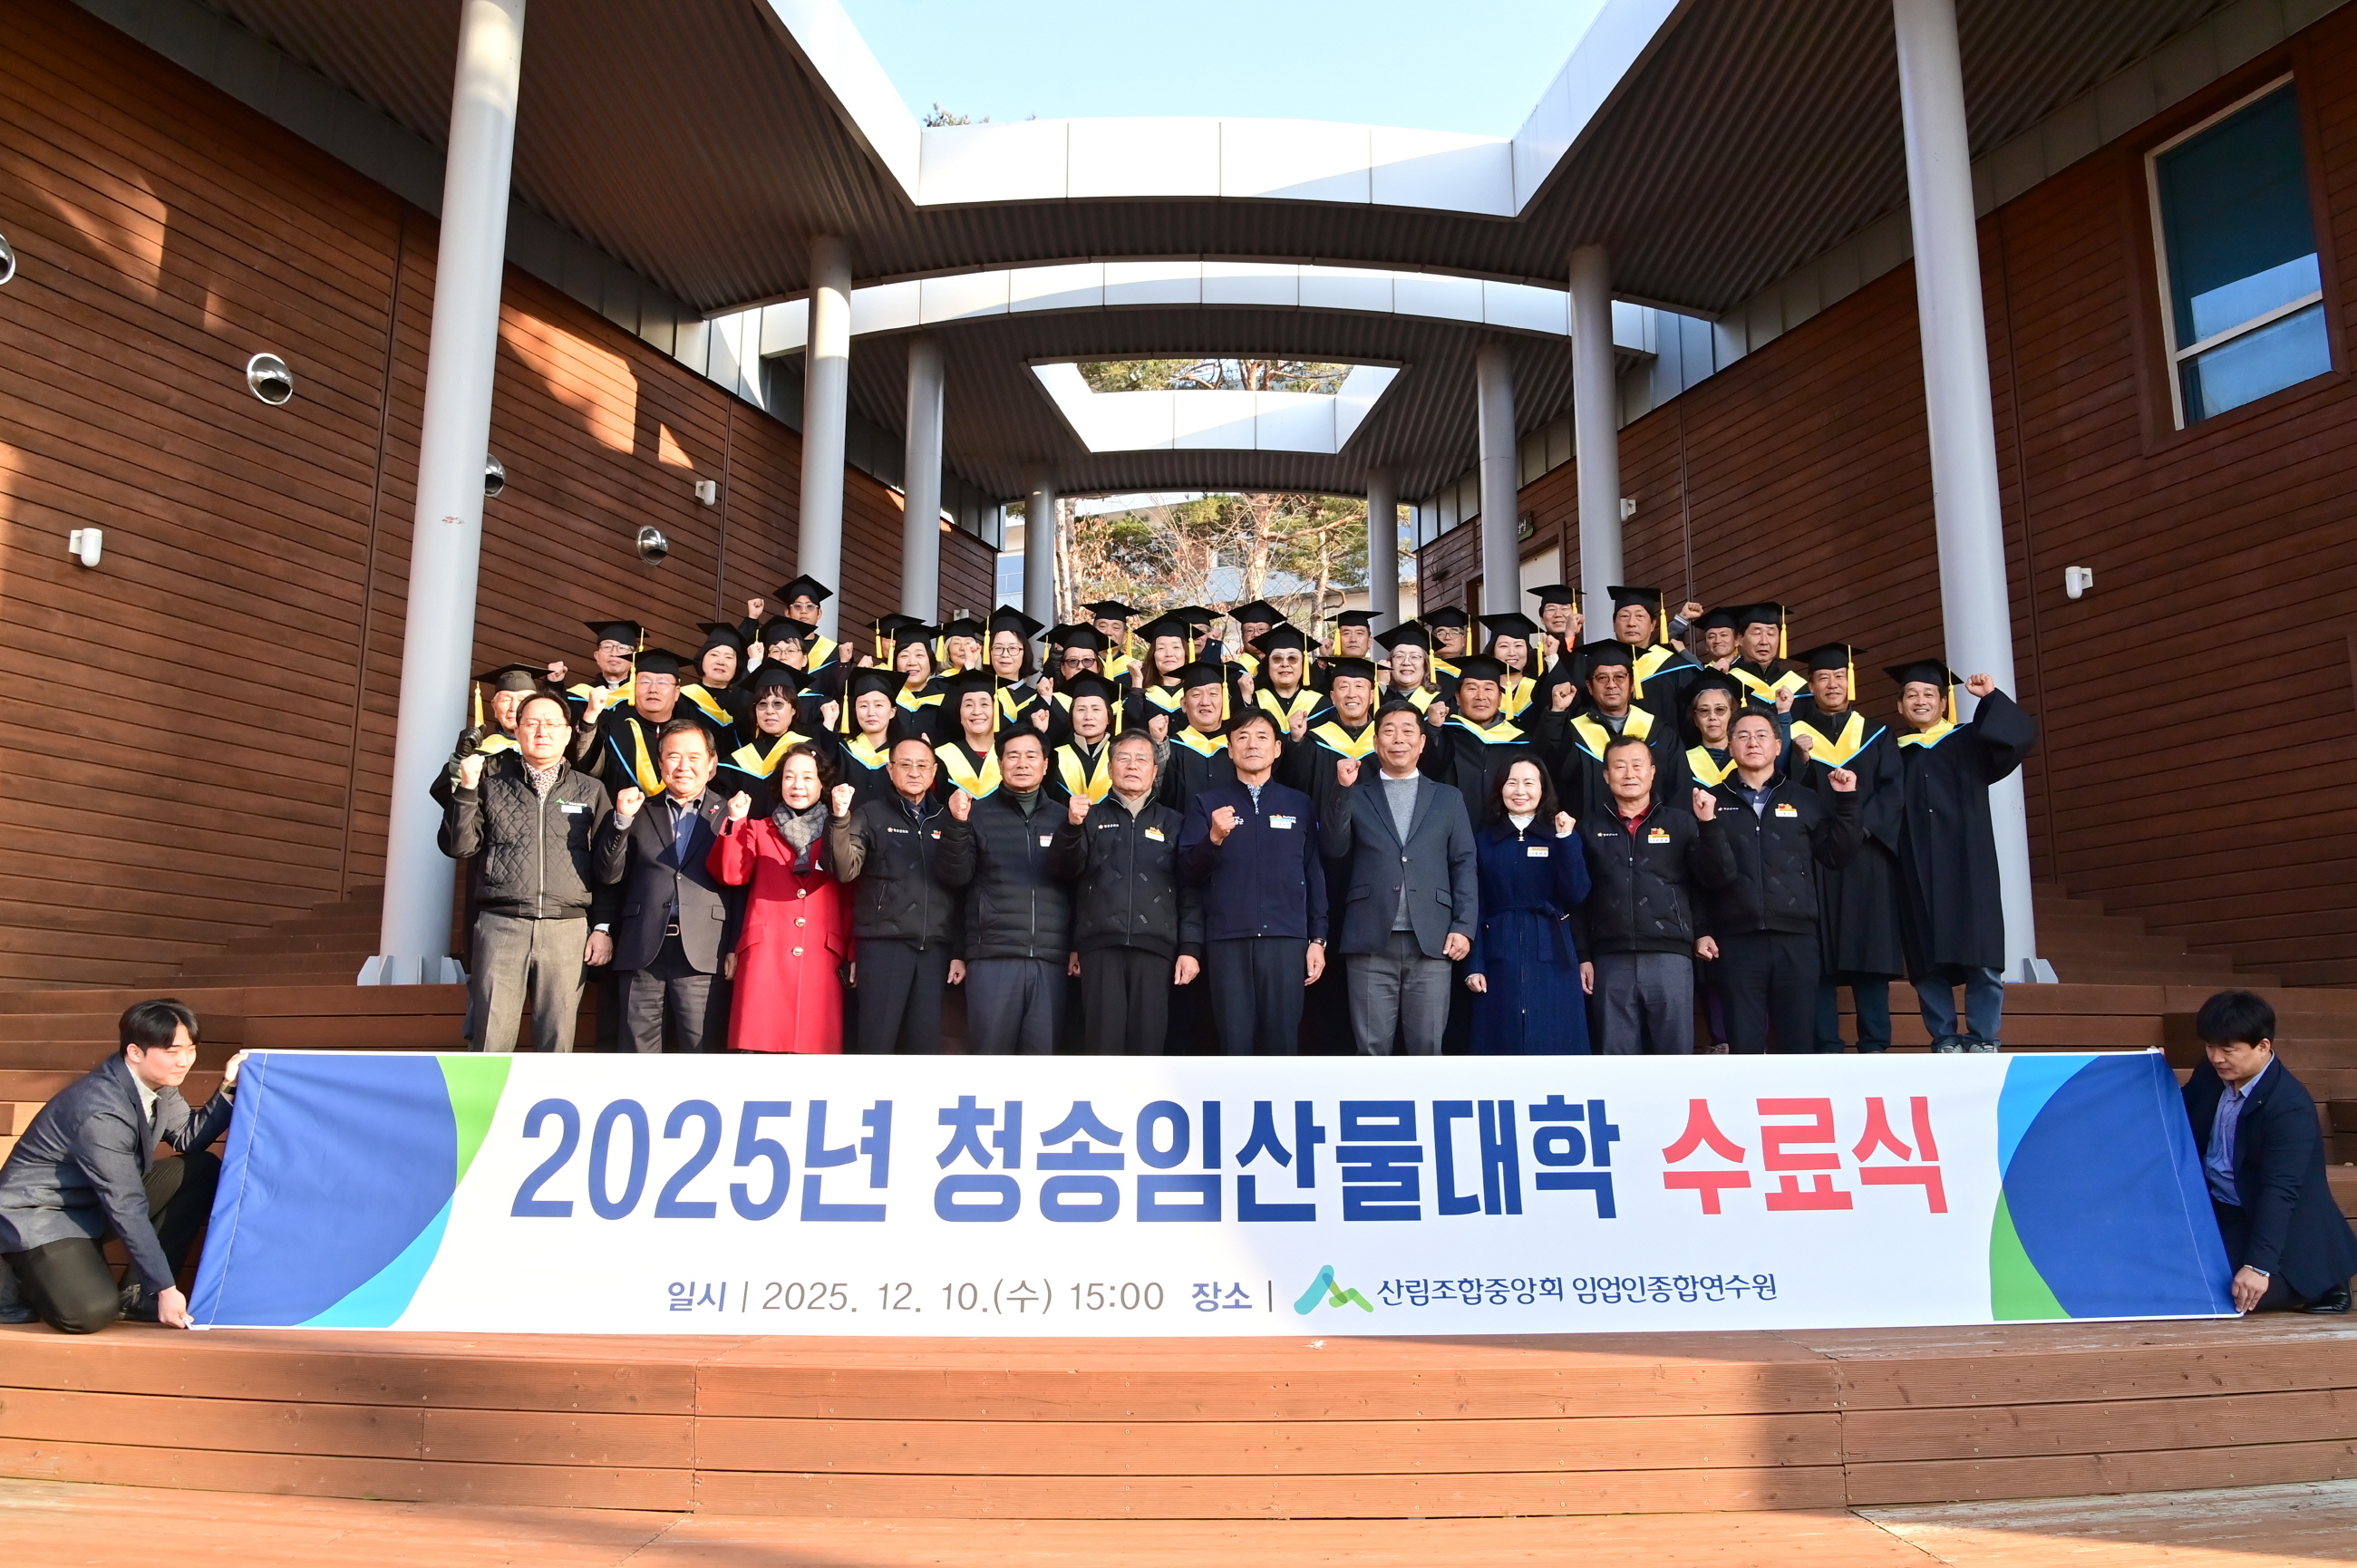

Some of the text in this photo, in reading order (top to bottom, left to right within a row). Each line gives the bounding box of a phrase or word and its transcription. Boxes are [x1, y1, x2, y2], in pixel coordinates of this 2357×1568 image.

[509, 1094, 1949, 1224] 2025년 청송임산물대학 수료식
[667, 1281, 726, 1312] 일시
[761, 1282, 858, 1312] 2025.
[878, 1282, 921, 1312] 12.
[1071, 1282, 1164, 1312] 15:00
[1191, 1281, 1253, 1312] 장소
[1376, 1273, 1778, 1307] 산림조합중앙회 임업인종합연수원
